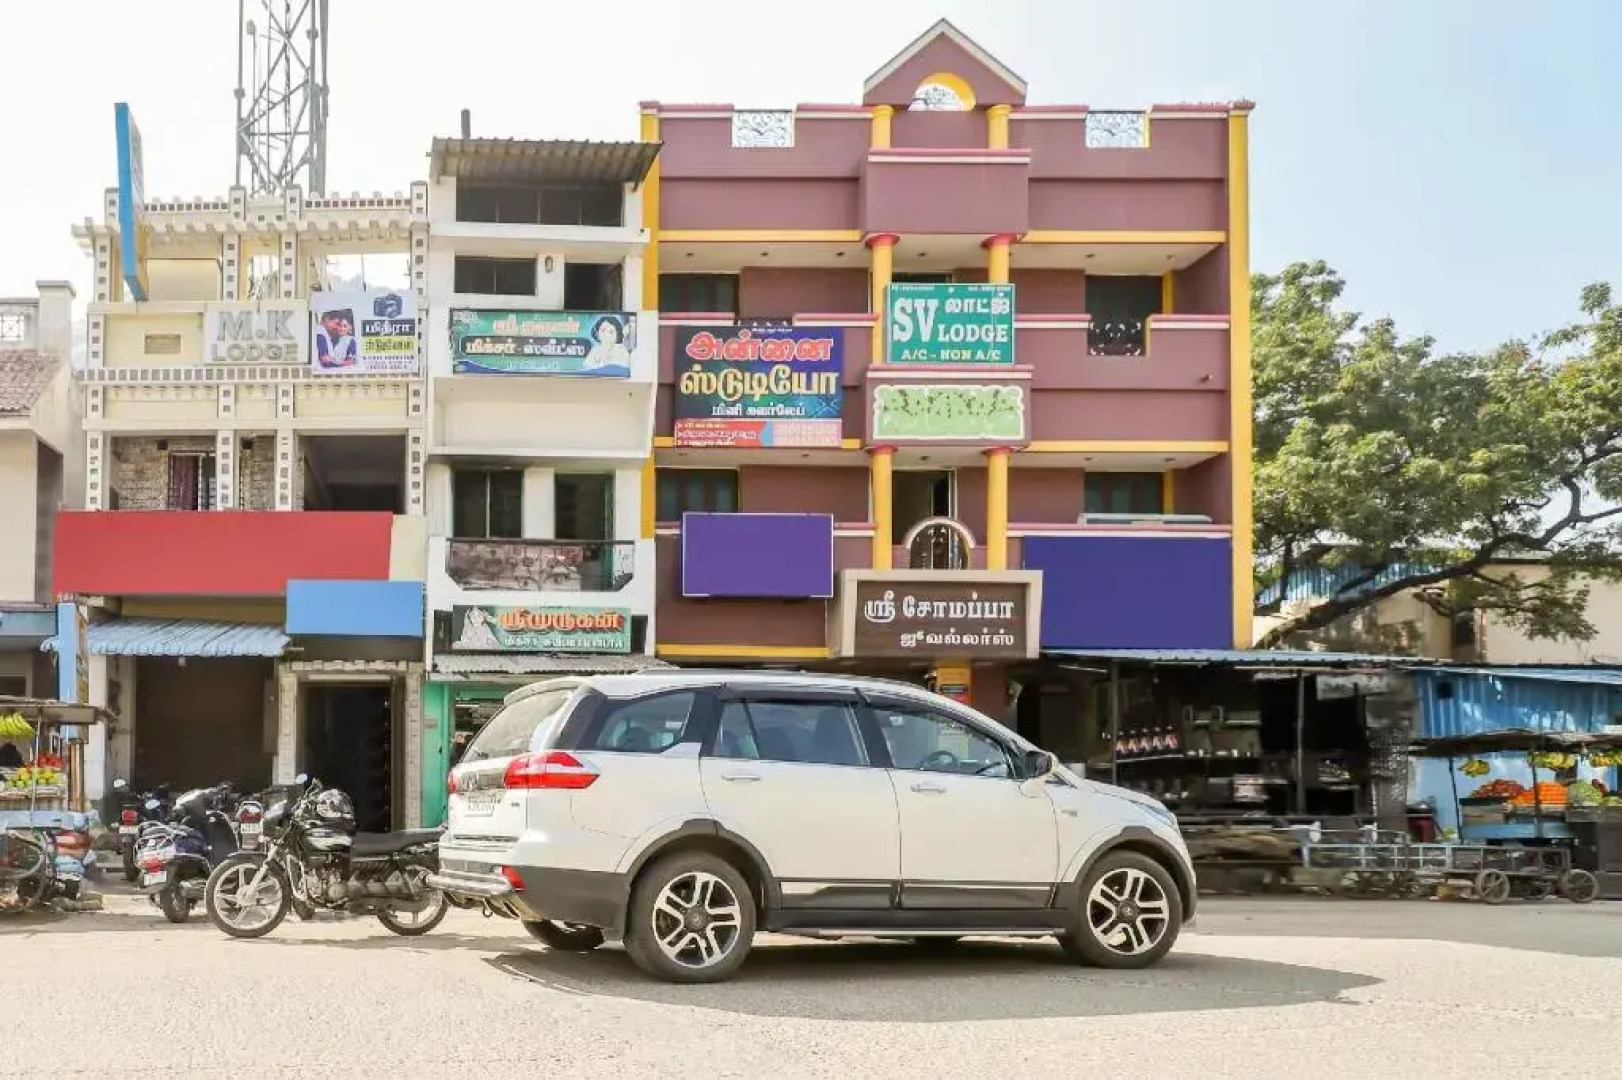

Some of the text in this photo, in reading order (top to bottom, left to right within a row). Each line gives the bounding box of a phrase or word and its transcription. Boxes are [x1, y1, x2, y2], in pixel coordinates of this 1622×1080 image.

[945, 293, 1009, 314] லாட்ஜ்
[893, 298, 1008, 343] SV LODGE
[211, 343, 298, 361] LODGE
[685, 328, 834, 362] அன்னை
[901, 350, 927, 360] A/C
[940, 350, 971, 360] NON
[975, 350, 1002, 360] A/C
[680, 363, 839, 401] ஸ்டுடியோ
[712, 403, 742, 416] மினி
[864, 590, 1015, 623] ஸ்ரீ சோமப்பா
